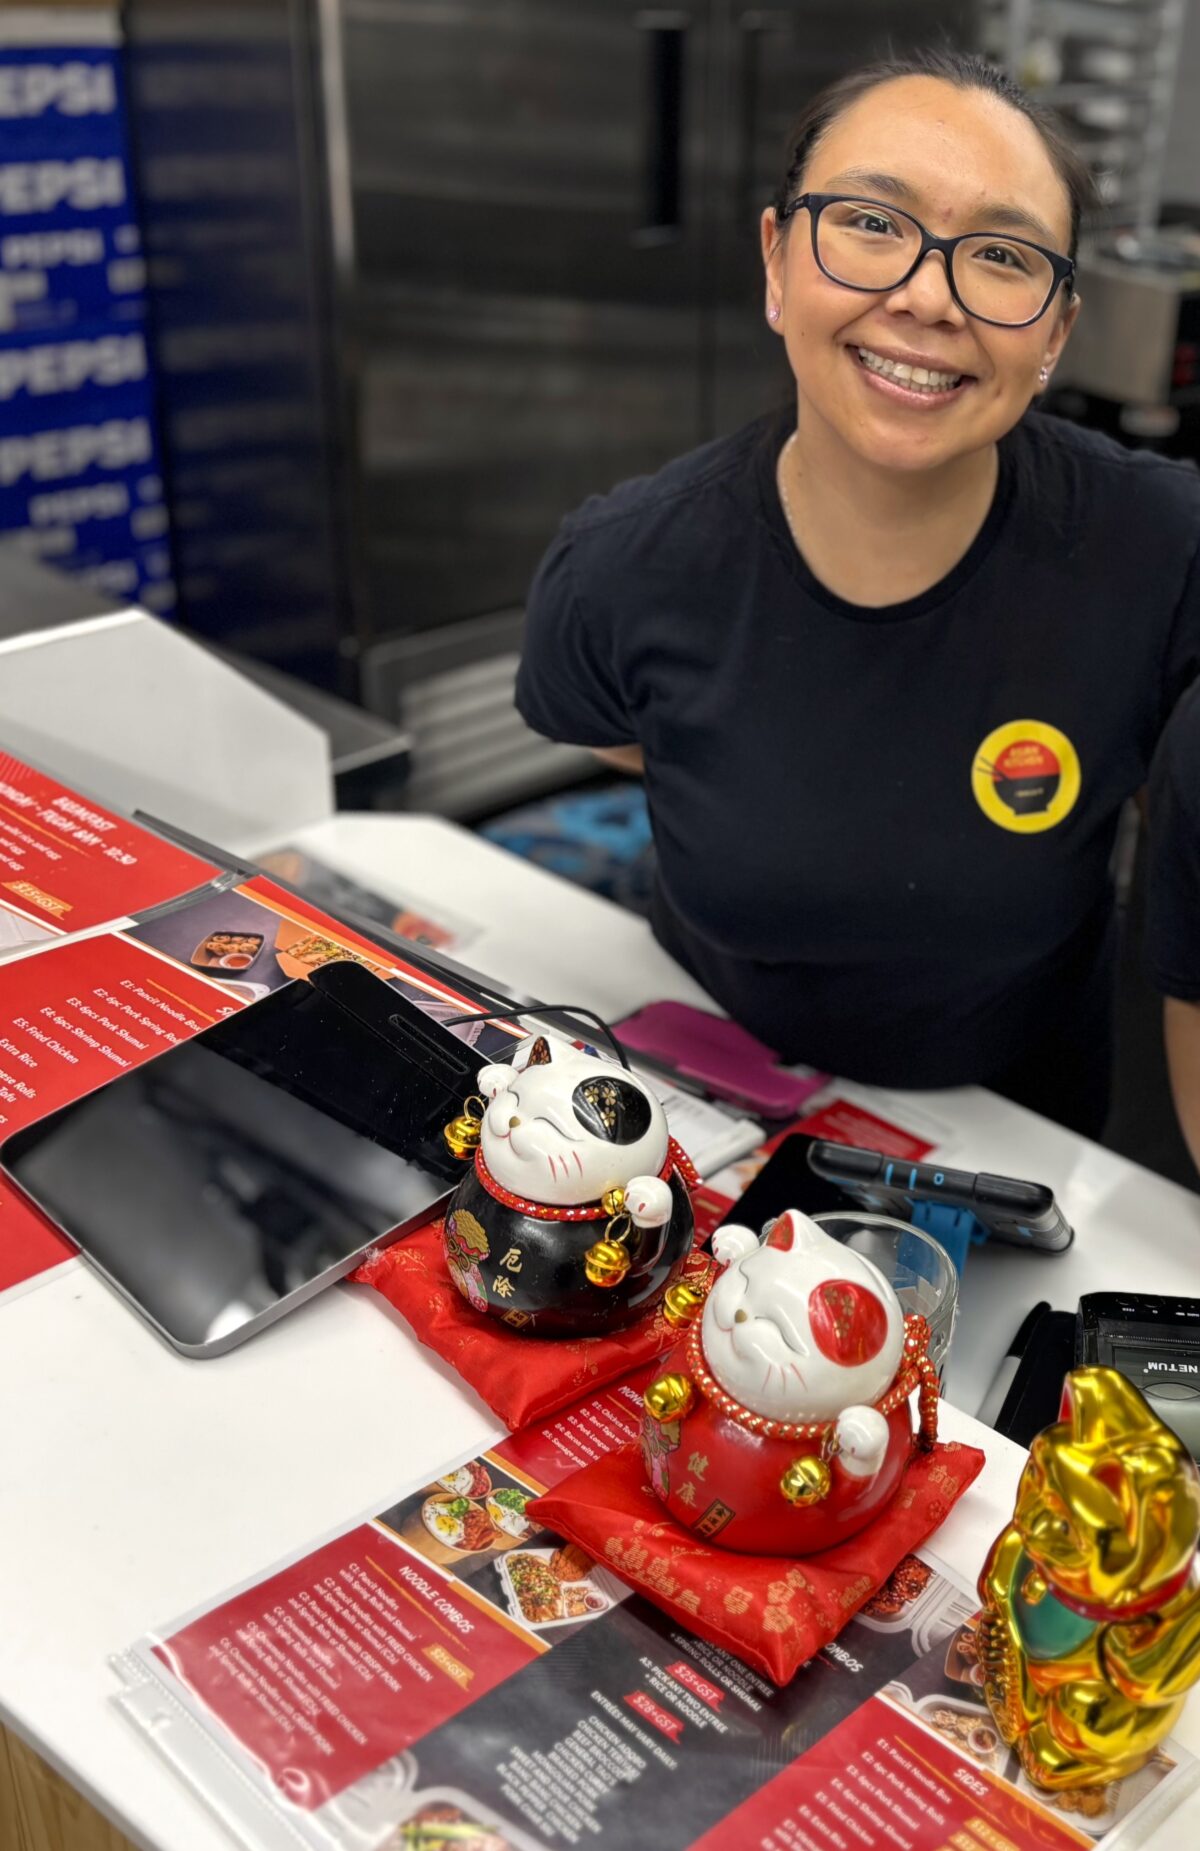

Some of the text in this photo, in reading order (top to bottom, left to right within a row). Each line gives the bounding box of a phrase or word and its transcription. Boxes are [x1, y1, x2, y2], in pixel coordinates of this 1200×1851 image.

[28, 483, 129, 527] PEPSI
[36, 809, 80, 832] FRIDAY
[52, 796, 117, 832] BREAKFAST
[93, 988, 166, 1036] E2: 6pc Pork Spring
[120, 979, 133, 989] E1:
[132, 987, 159, 1005] Pancit
[158, 1002, 186, 1023] Noodle
[13, 1017, 79, 1064] E5: Fried Chicken
[40, 1006, 132, 1068] E4: 6pcs Shrimp Shumai
[66, 997, 81, 1008] E3:
[79, 1006, 100, 1021] 6pcs
[98, 1016, 118, 1032] Pork
[115, 1029, 150, 1051] Shumai
[17, 1053, 38, 1068] Rice
[13, 1081, 37, 1098] Rolls
[1147, 1361, 1198, 1374] NETUM
[339, 1569, 416, 1641] with Spring Rolls and Shumai
[349, 1563, 399, 1609] C1: Pancit Noodles
[399, 1566, 474, 1633] NOODLE COMBOS
[323, 1578, 432, 1681] C2: Pancit Noodles with FRIED CHICKEN
[430, 1648, 465, 1679] $25+GST
[674, 1636, 700, 1658] SPRING
[699, 1657, 721, 1676] ROLLS
[720, 1676, 732, 1685] OR
[730, 1685, 761, 1711] SHUMAI
[674, 1665, 717, 1702] $25+GST
[711, 1656, 723, 1666] OR
[722, 1665, 752, 1691] NOODLE
[633, 1695, 676, 1732] $28+GST
[649, 1677, 666, 1691] RICE
[664, 1691, 677, 1701] OR
[675, 1700, 706, 1727] NOODLE
[651, 1666, 671, 1682] PICK
[667, 1680, 684, 1694] ANY
[682, 1693, 701, 1709] TWO
[699, 1708, 727, 1732] ENTREE
[576, 1720, 610, 1749] CHICKEN
[587, 1715, 621, 1744] CHICKEN
[619, 1716, 638, 1732] MAY
[634, 1731, 655, 1748] VARY
[860, 1751, 947, 1824] E2: 6pc Pork Spring Rolls
[876, 1738, 953, 1803] E1: Pancit Noodle Box
[953, 1768, 989, 1795] SIDES
[845, 1765, 921, 1828] E3: 6pcs Pork Shumai
